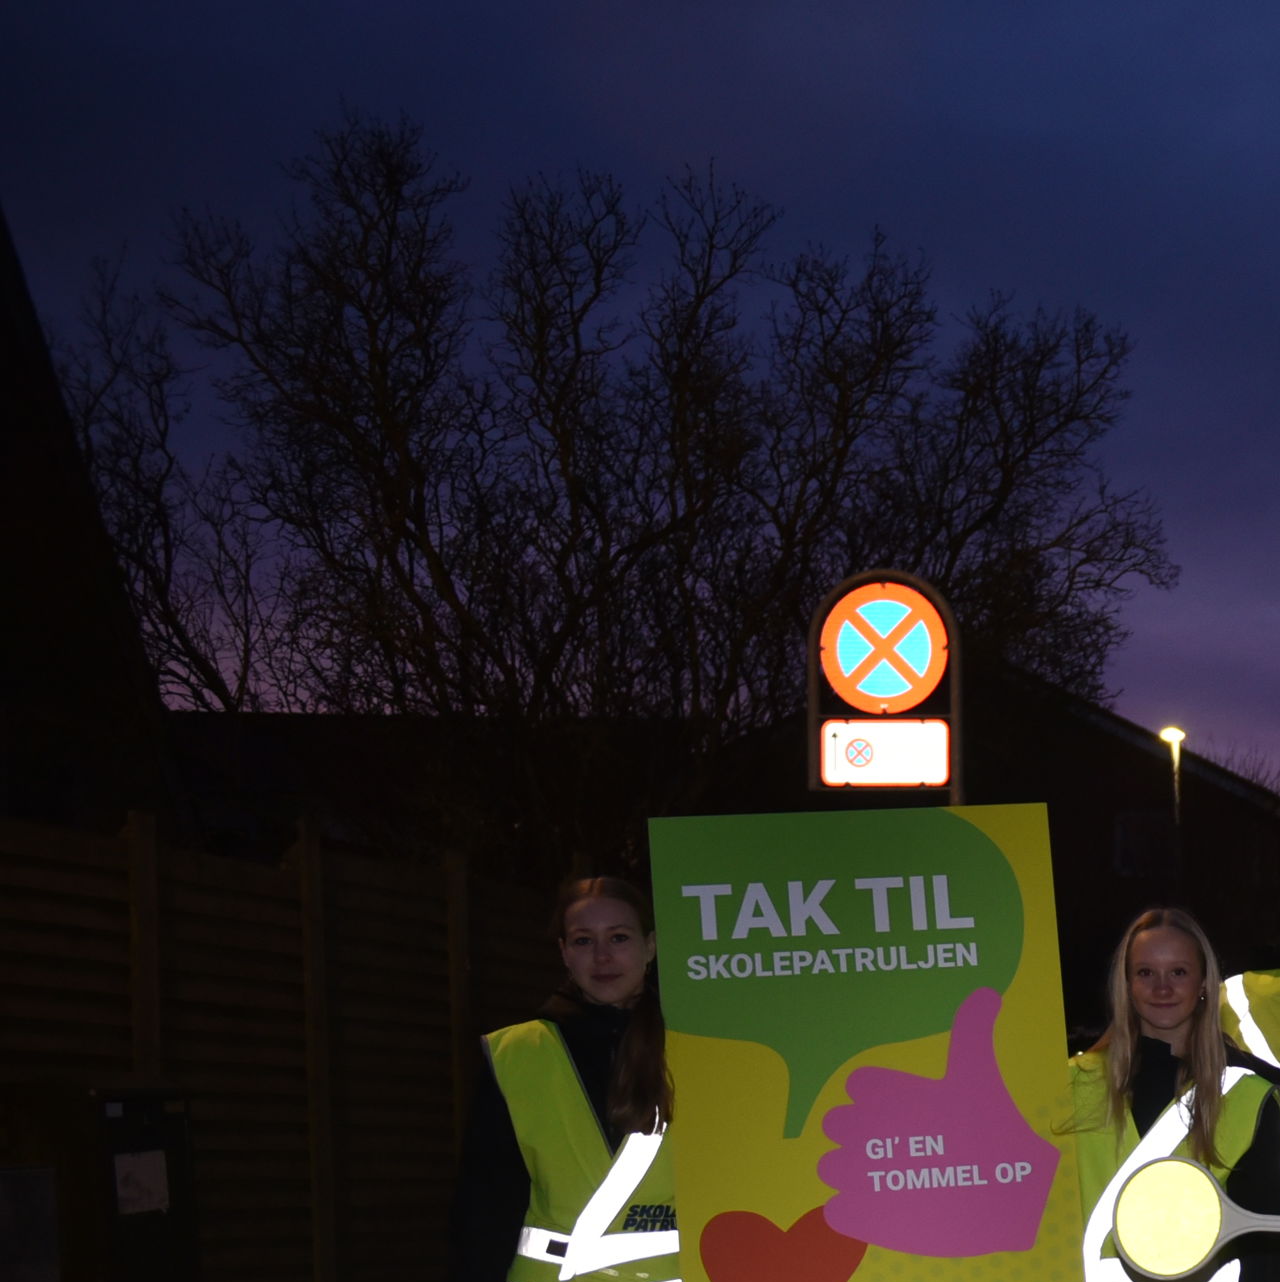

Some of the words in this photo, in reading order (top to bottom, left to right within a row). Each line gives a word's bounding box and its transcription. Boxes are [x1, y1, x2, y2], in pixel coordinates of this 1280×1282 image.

[681, 879, 840, 941] TAK
[854, 874, 975, 932] TIL
[687, 942, 978, 980] SKOLEPATRULJEN
[909, 1135, 944, 1157] EN
[867, 1165, 988, 1192] TOMMEL
[995, 1161, 1032, 1184] OP
[627, 1204, 676, 1218] SKOL
